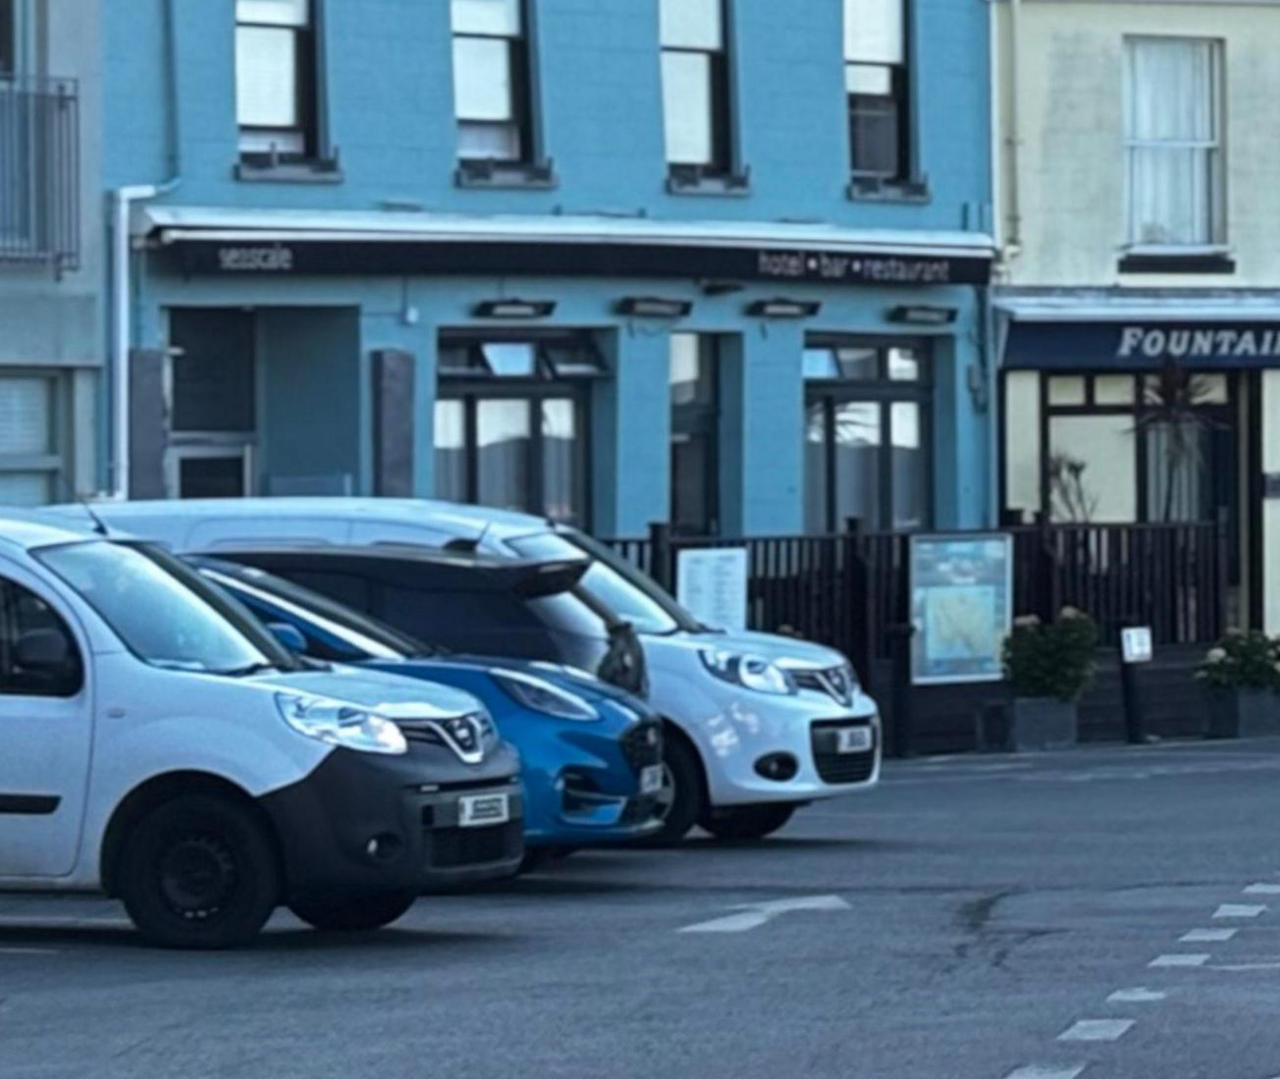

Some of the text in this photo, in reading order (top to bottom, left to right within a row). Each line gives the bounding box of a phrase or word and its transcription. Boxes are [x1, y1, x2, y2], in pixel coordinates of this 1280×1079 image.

[758, 251, 949, 281] hotel bar restaurant
